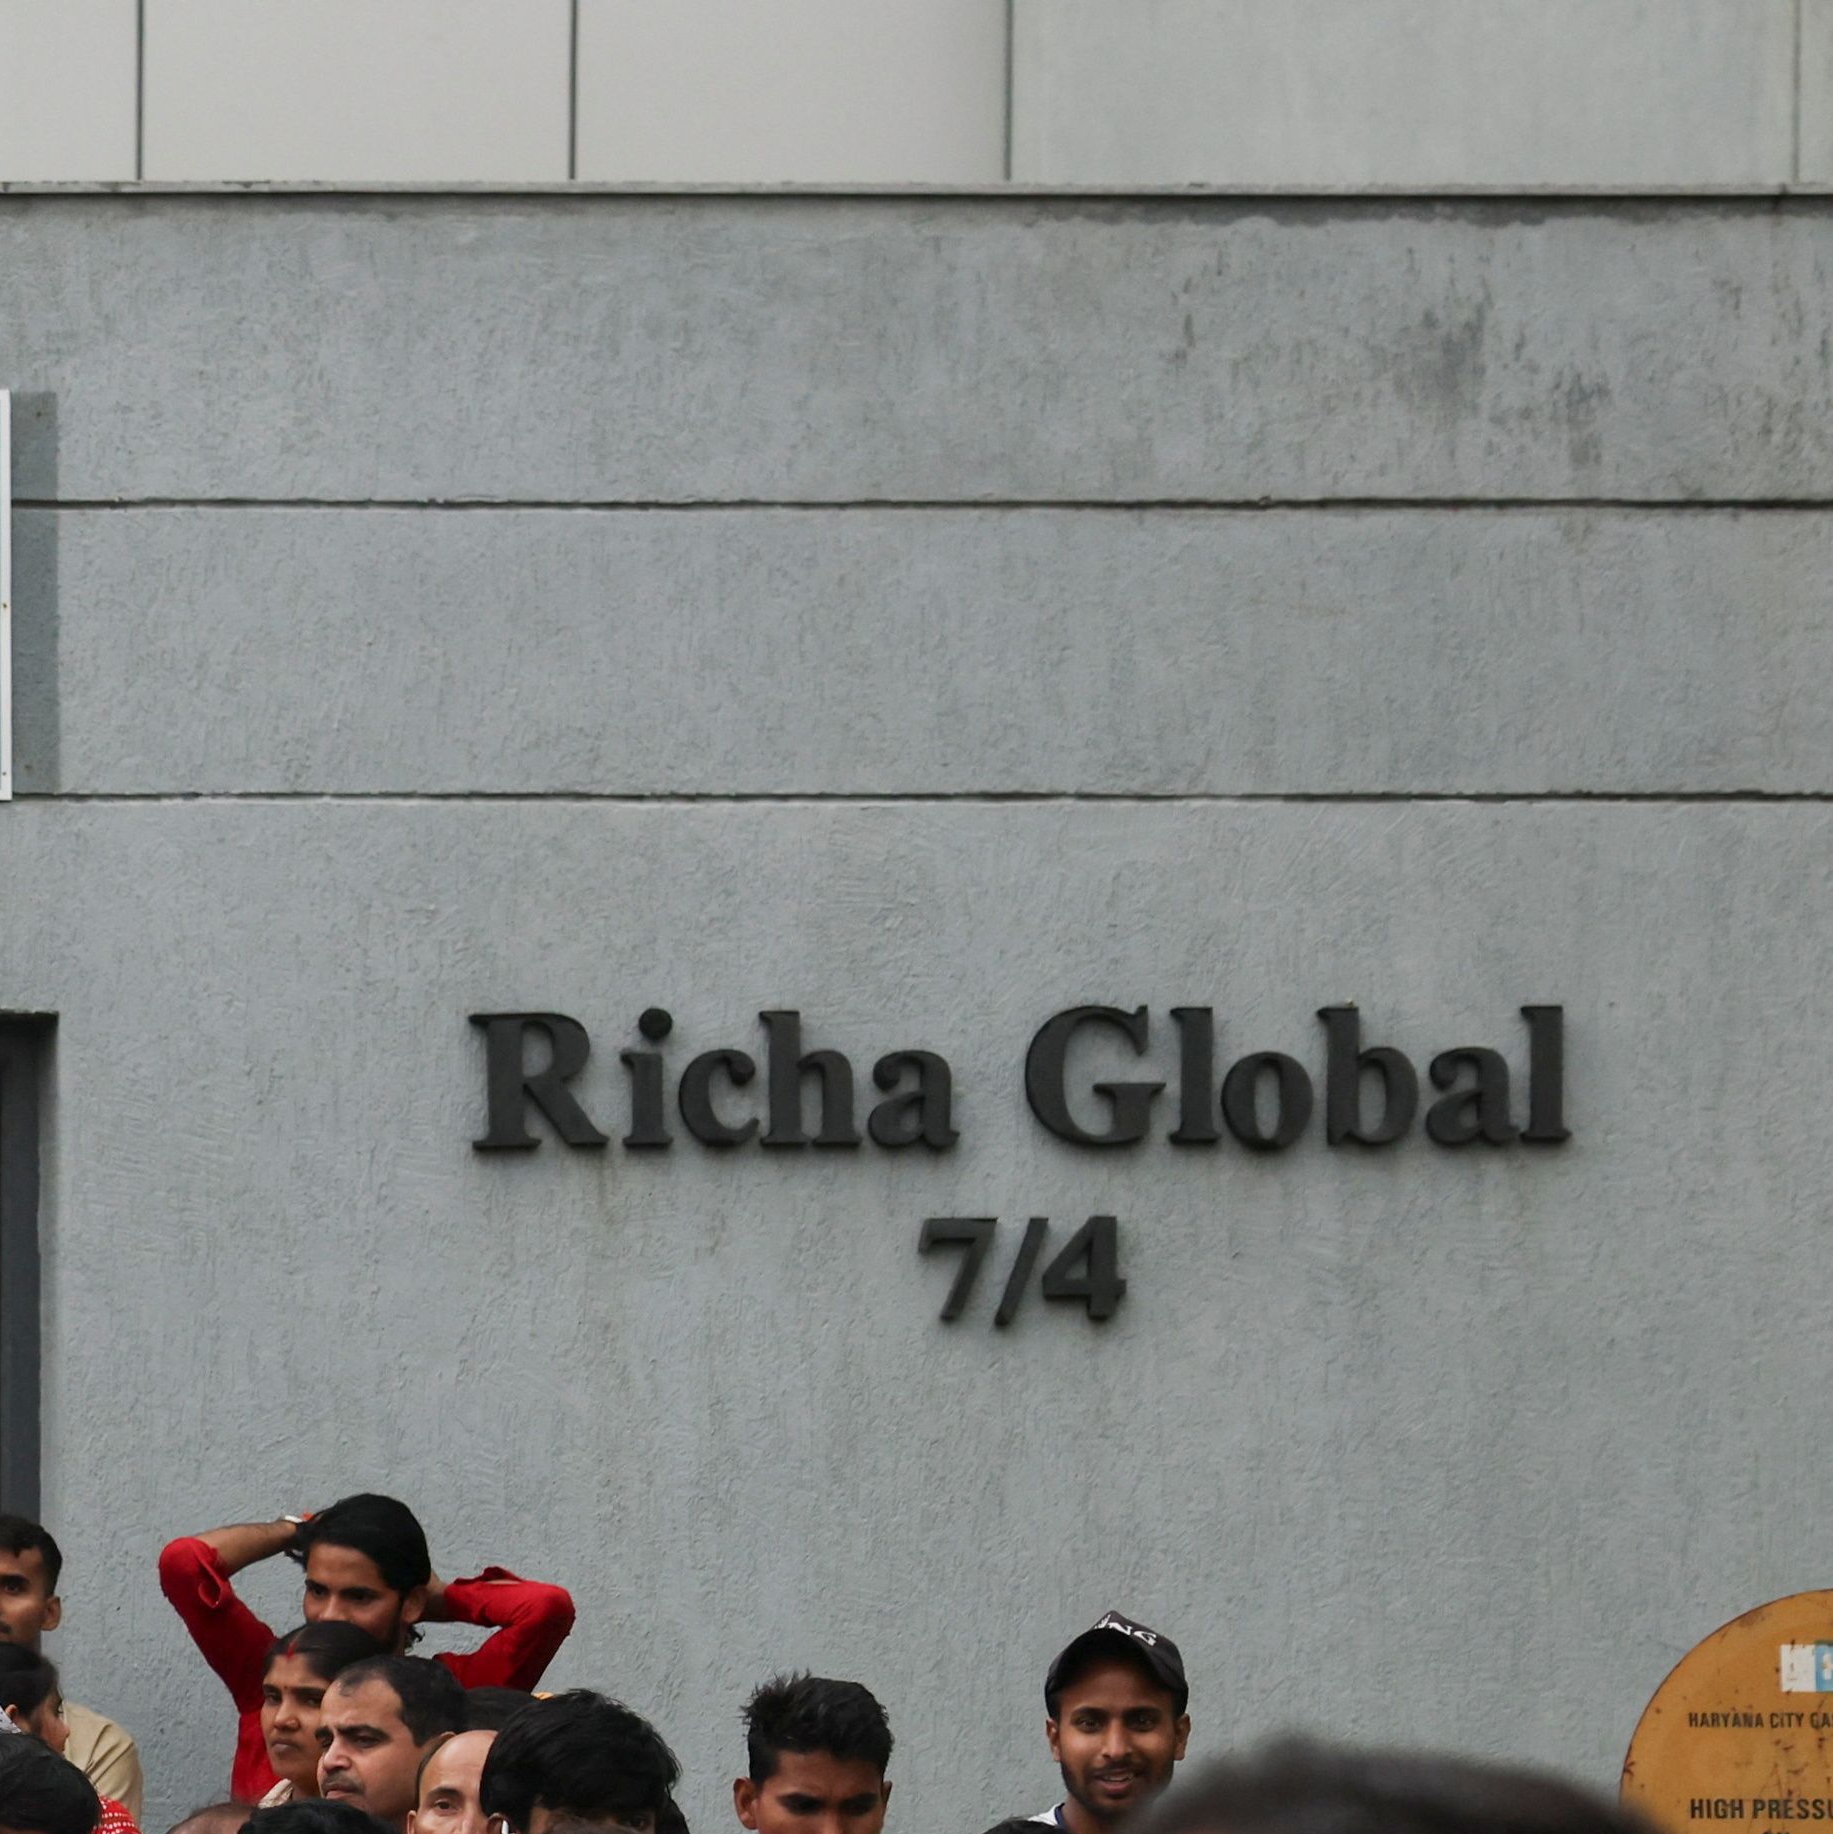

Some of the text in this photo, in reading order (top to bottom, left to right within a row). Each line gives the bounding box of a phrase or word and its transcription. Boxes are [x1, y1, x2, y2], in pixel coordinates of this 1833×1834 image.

[468, 1002, 1572, 1156] Richa Global
[918, 1216, 1127, 1330] 7/4
[1688, 1711, 1833, 1730] HARYANA CITY GA
[1690, 1798, 1745, 1820] HIGH
